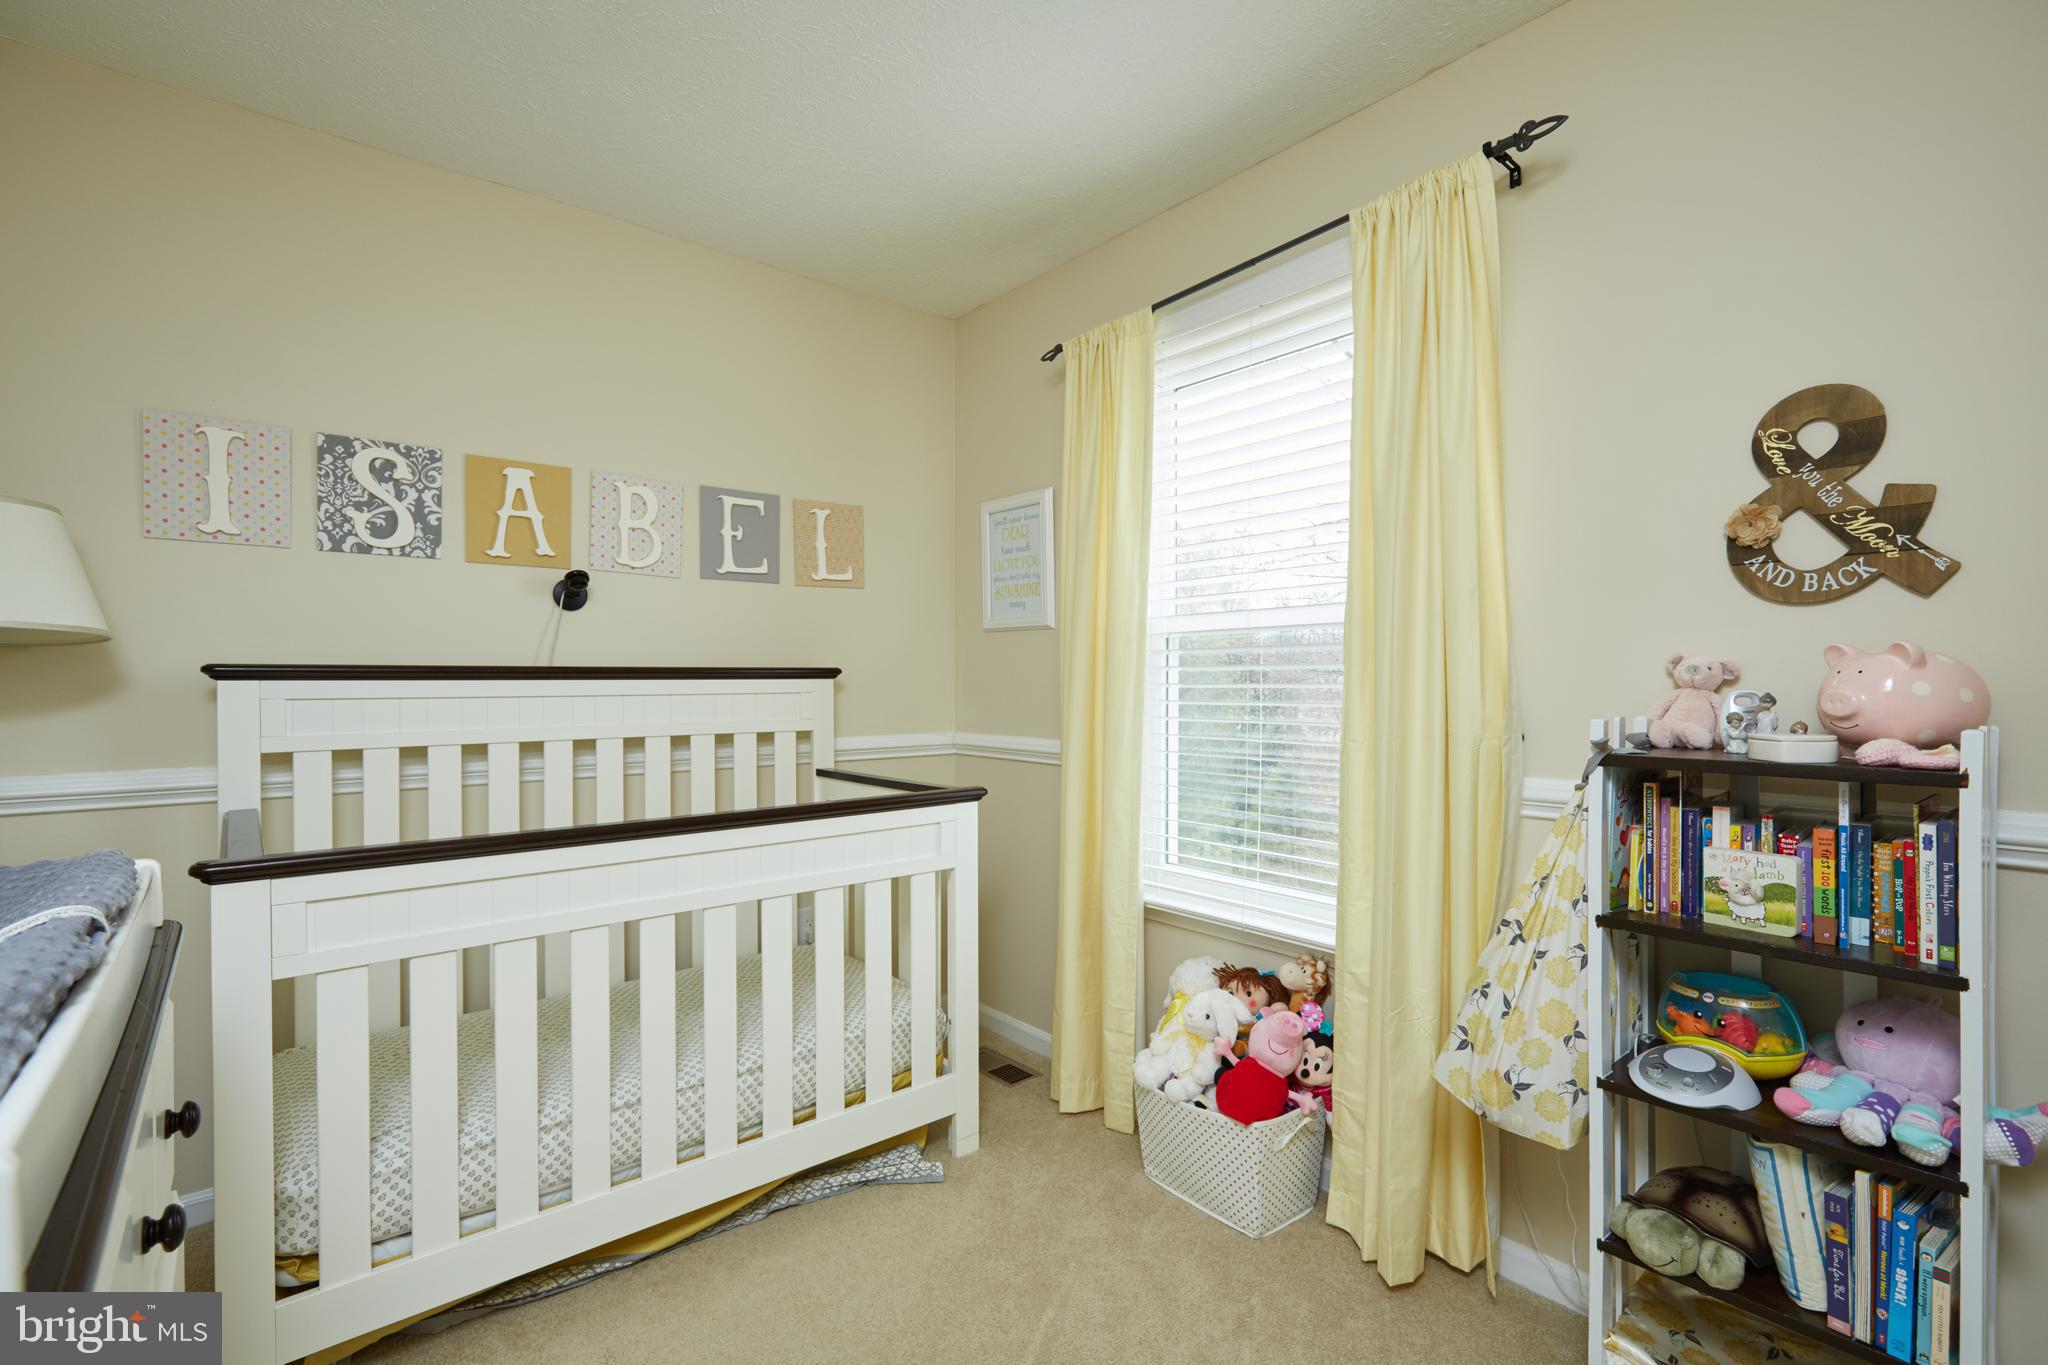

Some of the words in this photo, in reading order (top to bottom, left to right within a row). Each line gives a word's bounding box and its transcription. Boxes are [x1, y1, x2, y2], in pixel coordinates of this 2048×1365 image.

[1758, 428, 1796, 475] Love
[1792, 463, 1822, 487] you
[1817, 481, 1844, 507] the
[1001, 523, 1030, 543] DEAR
[1829, 505, 1900, 558] Moon
[997, 557, 1021, 571] LOVE
[1021, 554, 1040, 569] YOU
[1744, 554, 1795, 588] AND
[1802, 556, 1878, 592] BACK
[994, 581, 1040, 600] SUNSHINE
[1646, 829, 1654, 837] for
[1646, 837, 1654, 854] babies
[1722, 854, 1751, 868] Mary
[1756, 857, 1777, 869] had
[1821, 849, 1832, 870] first
[1943, 861, 1954, 872] Ten
[1754, 867, 1785, 881] lamb
[1821, 871, 1831, 887] 100
[1924, 861, 1935, 882] Peppa's
[1894, 878, 1903, 893] HOP
[1925, 884, 1935, 900] First
[1940, 874, 1954, 898] Wishing
[1821, 888, 1832, 915] words
[1895, 898, 1903, 912] POP
[1943, 899, 1954, 917] Stars
[1925, 902, 1935, 925] Colors
[1832, 1248, 1844, 1267] Time
[1828, 1266, 1844, 1282] for
[1833, 1283, 1846, 1301] Bed
